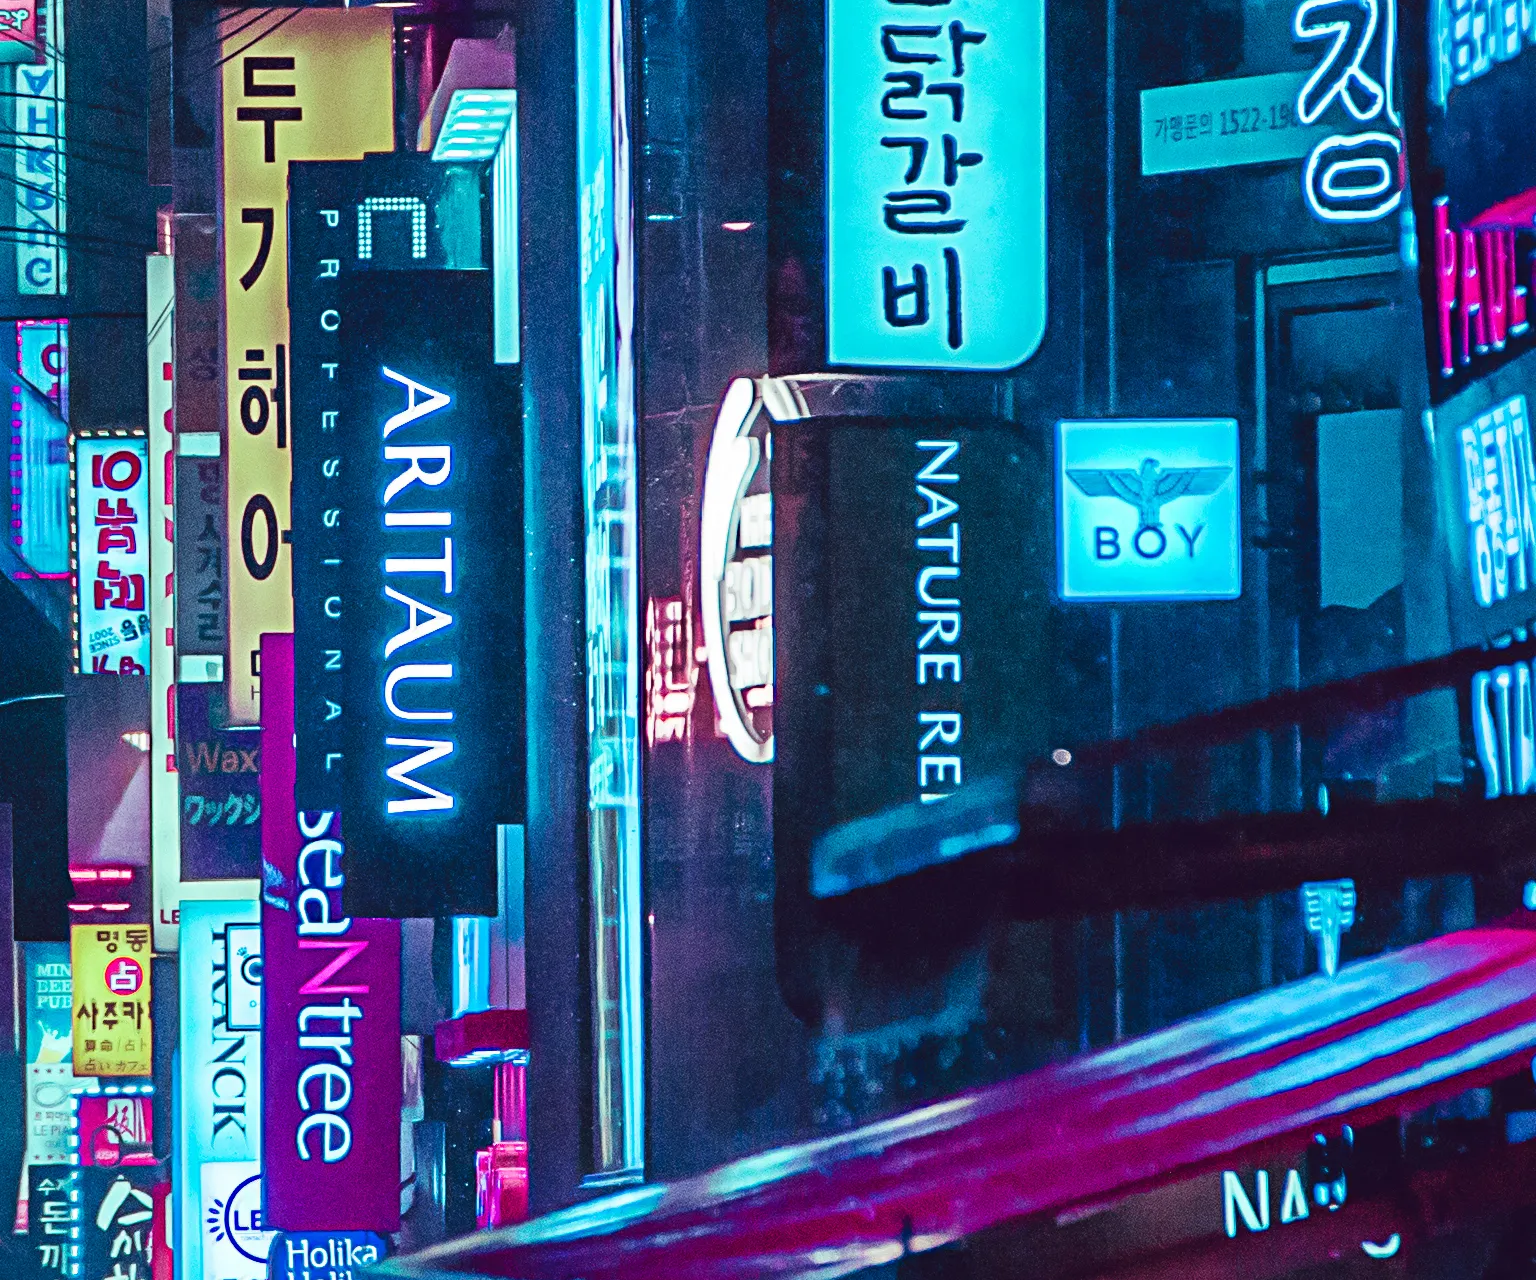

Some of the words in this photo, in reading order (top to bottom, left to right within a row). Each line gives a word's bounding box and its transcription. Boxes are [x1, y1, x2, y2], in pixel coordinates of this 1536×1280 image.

[1219, 104, 1300, 137] 1522-19
[1095, 525, 1205, 561] BOY
[915, 440, 962, 686] NATURE
[381, 364, 456, 816] ARITAUM
[184, 743, 260, 775] Wax
[916, 712, 963, 806] RE
[96, 928, 150, 953] 명동
[36, 962, 73, 979] MIN
[76, 1001, 152, 1032] 사주카
[285, 1239, 378, 1272] Holika
